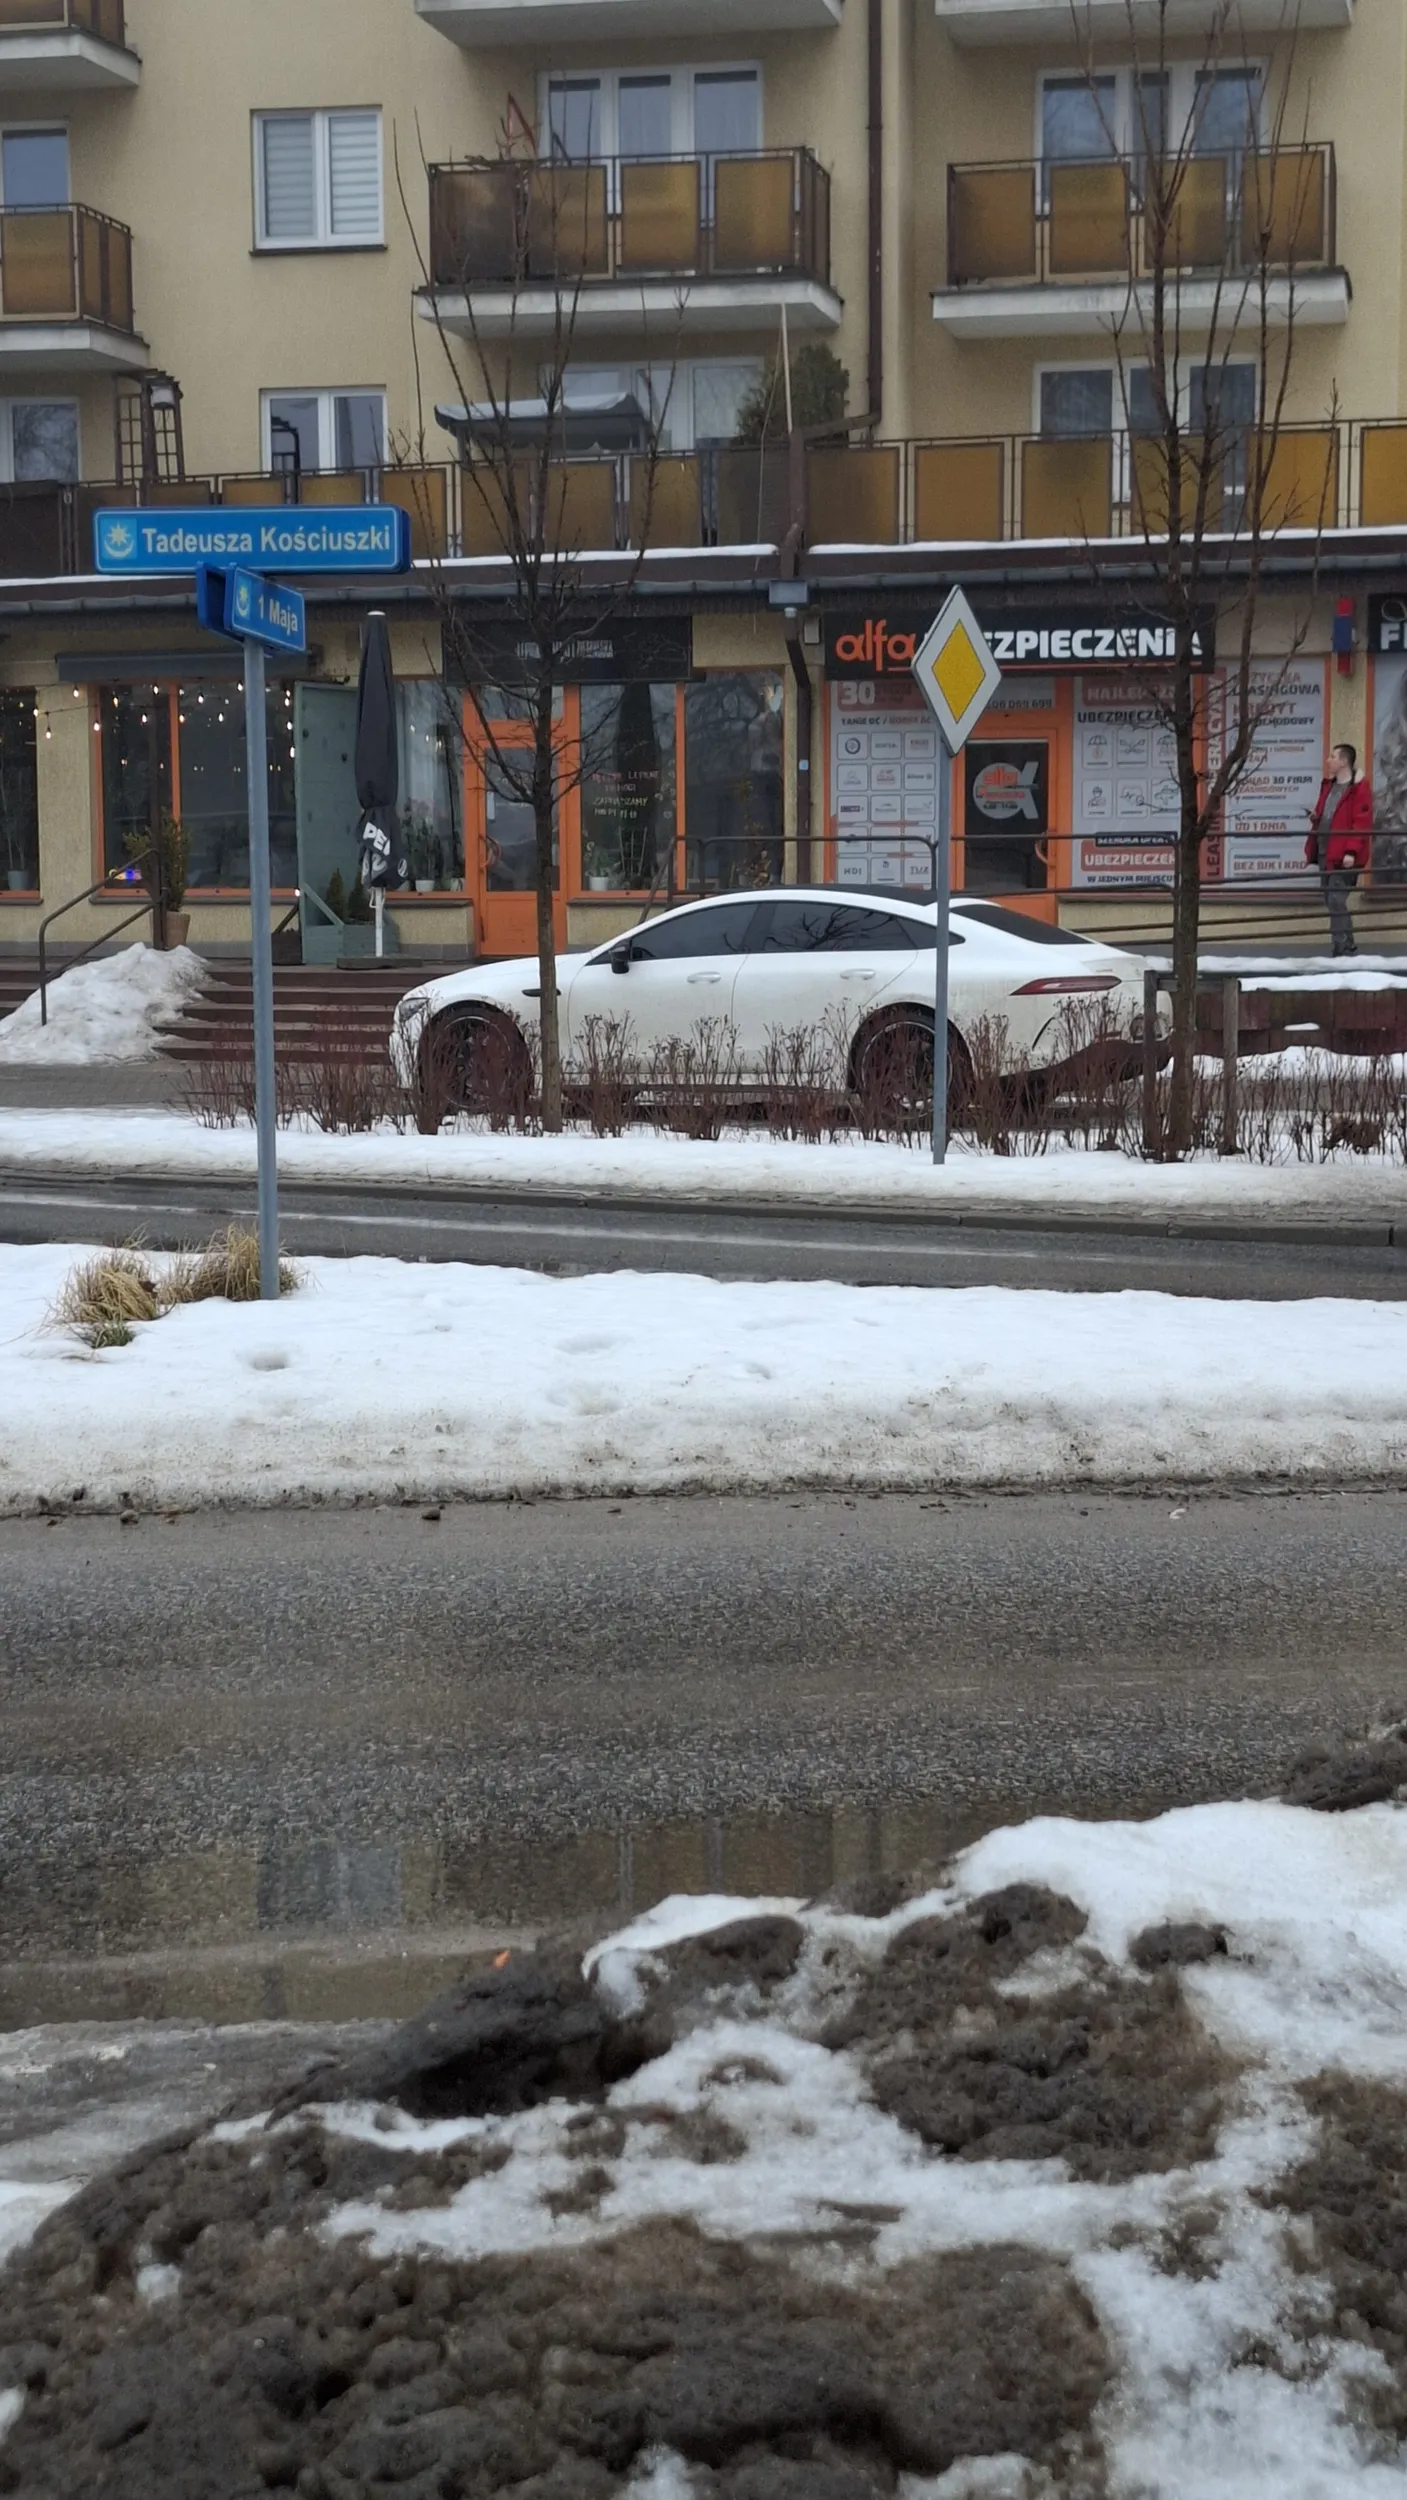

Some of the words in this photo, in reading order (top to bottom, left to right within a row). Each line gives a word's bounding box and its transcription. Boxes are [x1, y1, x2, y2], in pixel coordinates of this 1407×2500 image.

[142, 528, 252, 554] Tadeusza
[261, 525, 390, 553] Kościuszki
[258, 594, 265, 619] 1
[269, 599, 299, 636] Maja
[836, 619, 916, 672] alfa
[841, 681, 876, 705] 30
[843, 867, 862, 876] HDI
